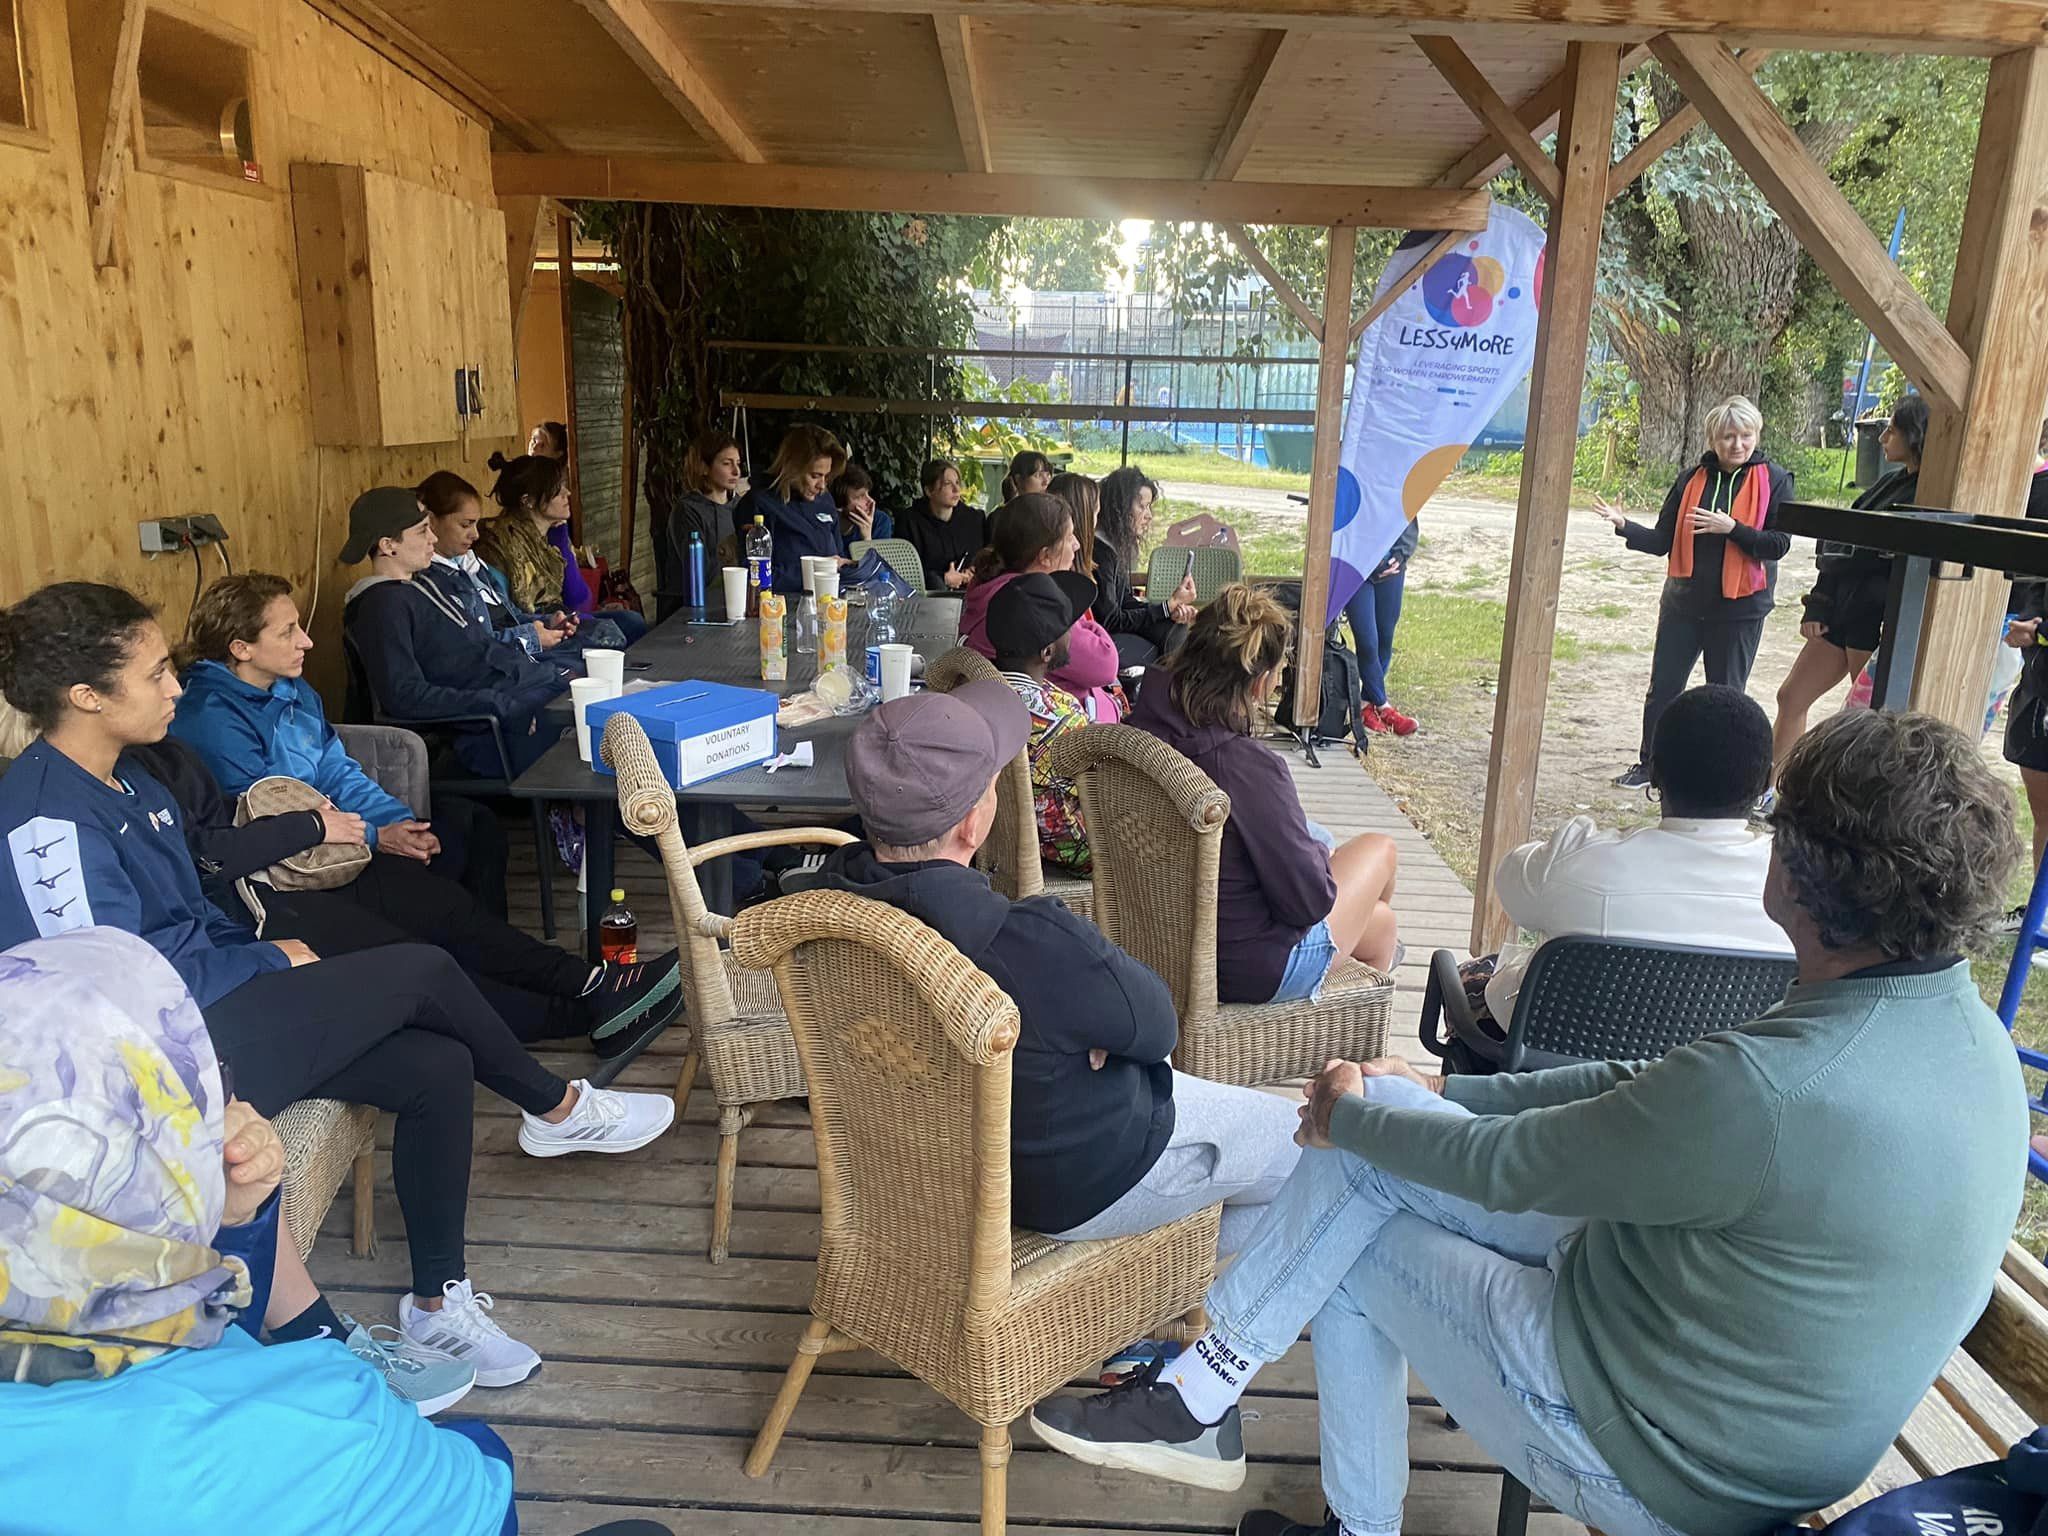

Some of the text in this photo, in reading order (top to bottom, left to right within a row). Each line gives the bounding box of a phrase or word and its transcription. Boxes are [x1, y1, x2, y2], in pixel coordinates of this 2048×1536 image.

[1393, 367, 1427, 378] WOMEN
[1428, 371, 1497, 385] EMPOWERMENT
[1414, 360, 1501, 376] LEVERAGING SPORTS
[705, 724, 750, 745] VOLUNTARY
[706, 742, 750, 764] DONATIONS
[1209, 1333, 1250, 1371] REBELS
[1214, 1352, 1228, 1365] OF
